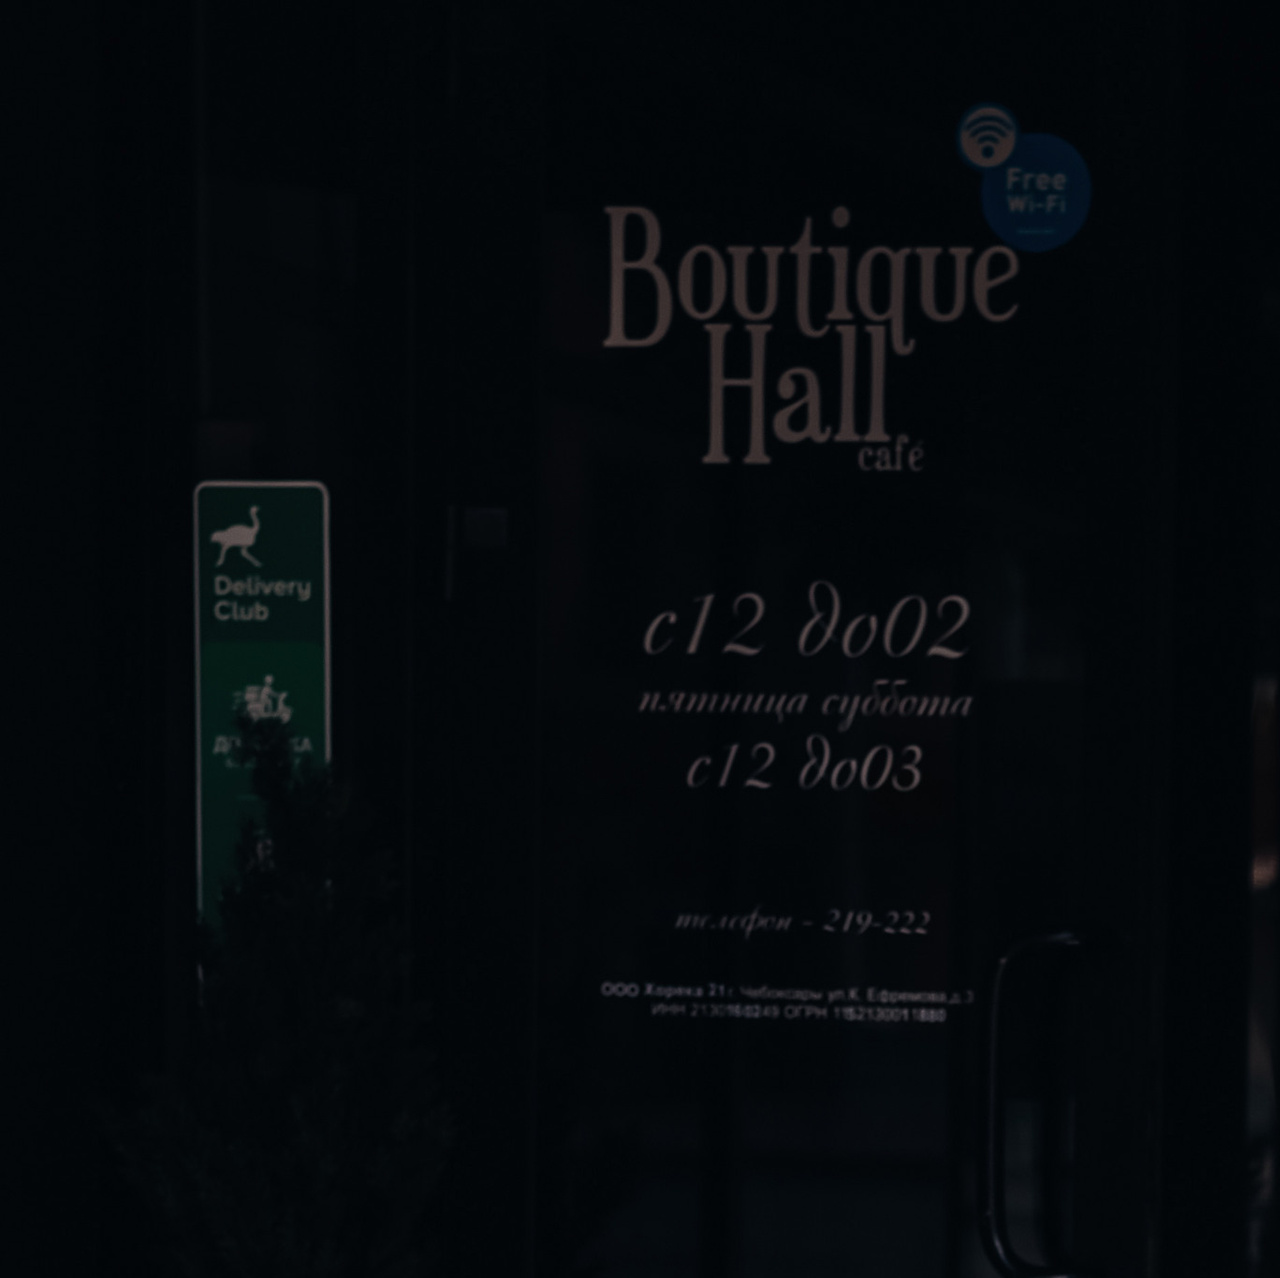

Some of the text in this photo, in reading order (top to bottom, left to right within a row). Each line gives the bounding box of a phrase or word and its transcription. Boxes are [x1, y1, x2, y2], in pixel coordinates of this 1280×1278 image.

[1006, 167, 1067, 191] Free
[1006, 194, 1067, 213] Wi-Fi
[603, 206, 1020, 355] Boutique
[701, 323, 901, 465] Hall
[857, 434, 925, 472] café
[213, 575, 311, 602] Delivery
[213, 601, 270, 622] Club
[642, 579, 971, 659] с12 до02
[638, 679, 974, 732] пятница суббота
[685, 734, 924, 791] с12 до03
[675, 903, 793, 940] телефон
[823, 908, 932, 935] 219-222
[600, 981, 641, 998] ООО
